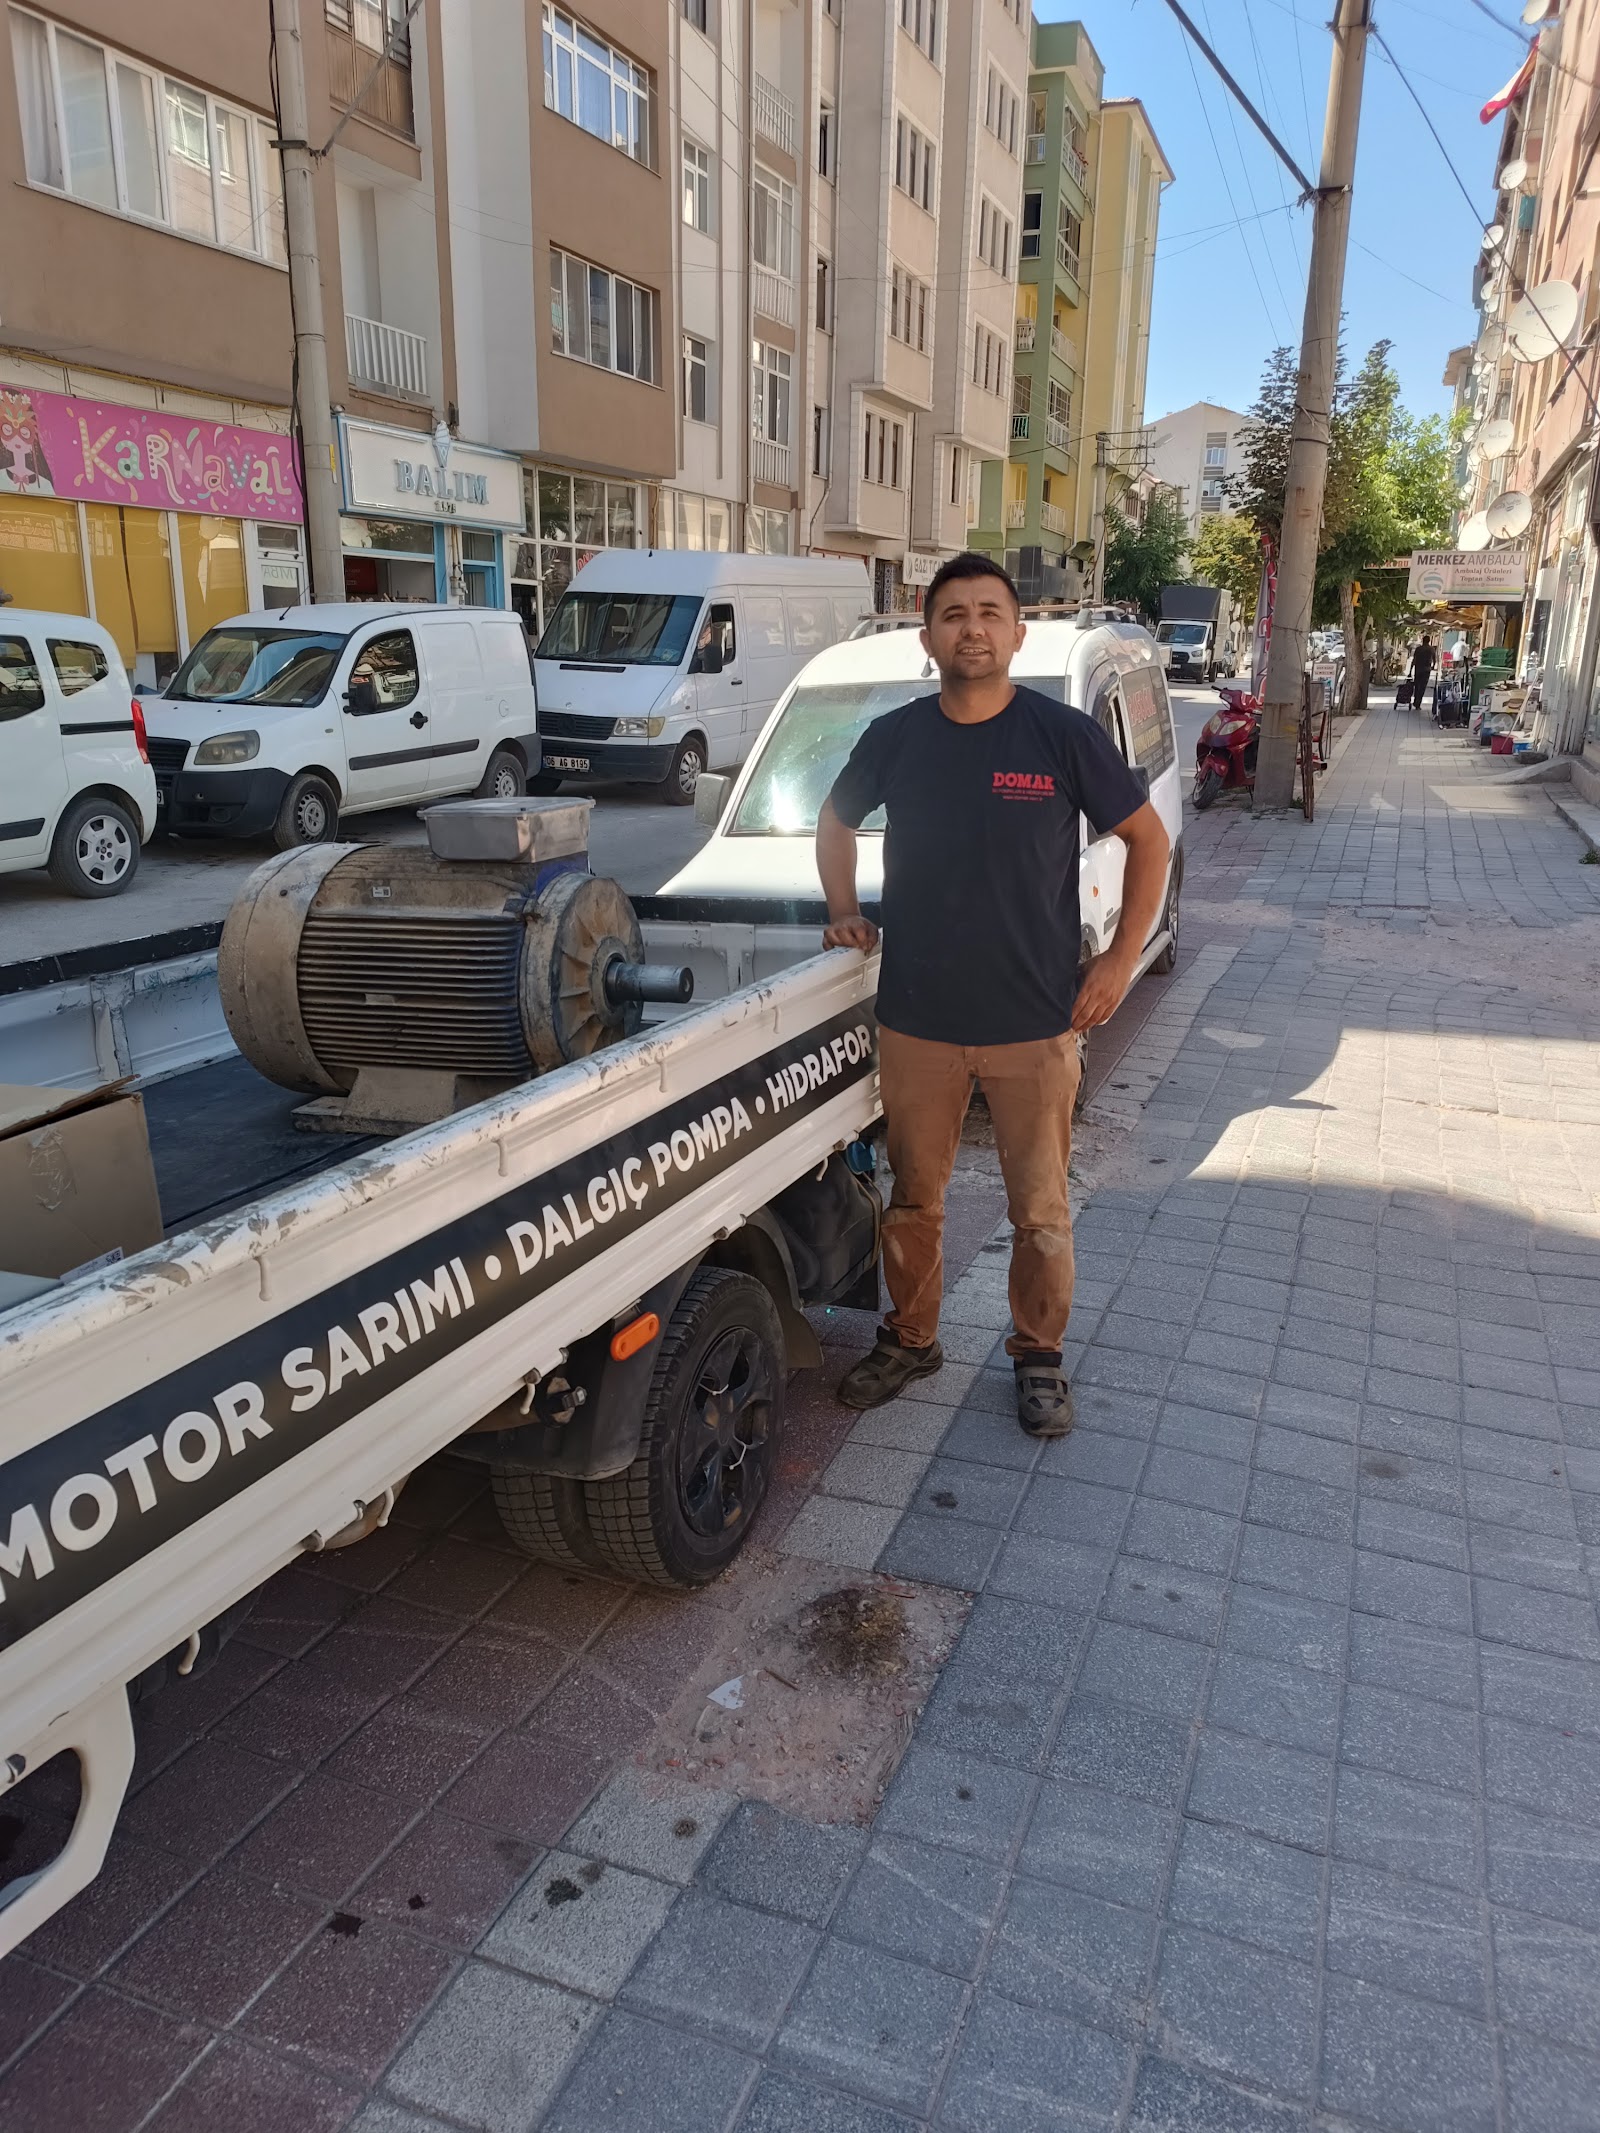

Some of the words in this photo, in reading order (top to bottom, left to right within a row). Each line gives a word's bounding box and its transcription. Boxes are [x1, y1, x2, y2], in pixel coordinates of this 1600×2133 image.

[394, 459, 489, 505] BALIM
[1417, 555, 1466, 565] MERKEZ
[1467, 555, 1522, 566] AMBALAJ
[546, 757, 555, 766] 06
[560, 758, 568, 767] AG
[571, 759, 588, 769] 8195
[0, 1381, 273, 1604] MOTOR
[281, 1257, 475, 1412] SARIMI
[506, 1157, 648, 1276] DALGIÇ
[647, 1097, 753, 1187] POMPA
